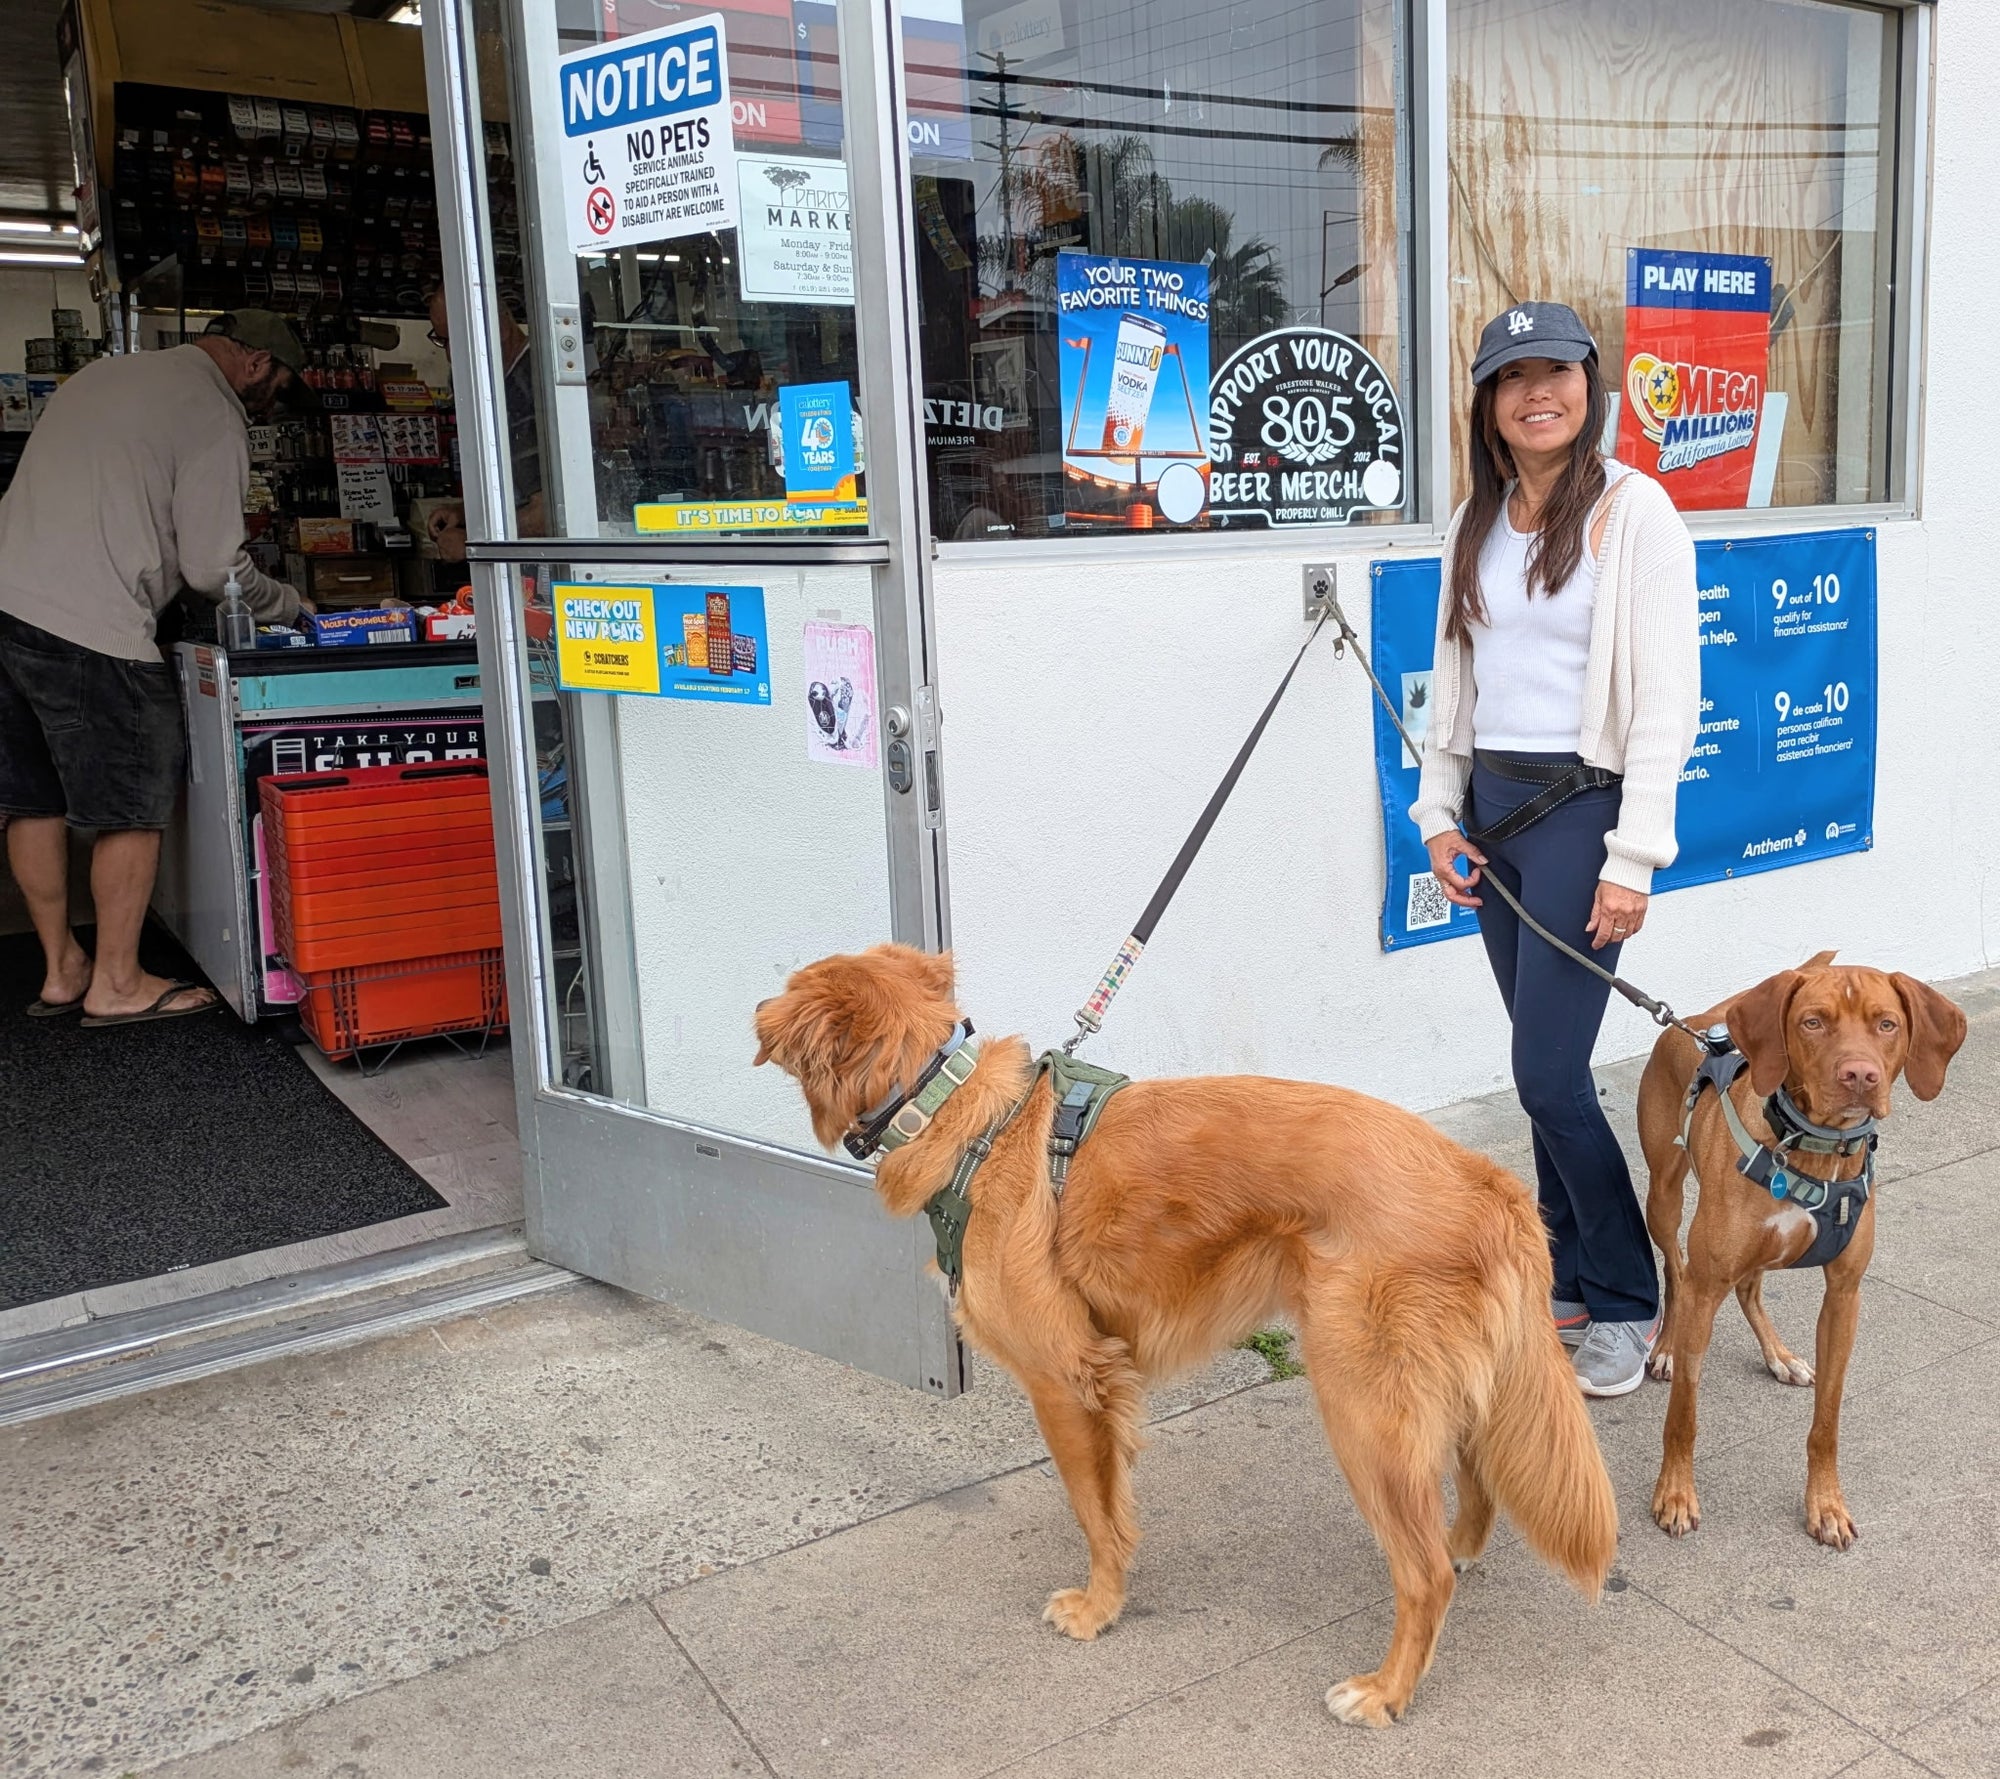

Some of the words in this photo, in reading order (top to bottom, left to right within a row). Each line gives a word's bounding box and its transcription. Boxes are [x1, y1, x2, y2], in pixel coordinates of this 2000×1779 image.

[570, 37, 714, 125] NOTICE
[626, 129, 655, 163] NO
[660, 117, 710, 156] PETS
[633, 158, 667, 176] SERVICE
[667, 150, 705, 168] ANIMALS
[625, 172, 679, 194] SPECIFICALLY
[680, 166, 715, 184] TRAINED
[624, 198, 634, 211] TO
[635, 195, 649, 209] AID
[650, 194, 657, 206] A
[657, 189, 690, 206] PERSON
[691, 185, 712, 200] WITH
[712, 182, 720, 195] A
[621, 207, 664, 228] DISABILITY
[665, 204, 682, 220] ARE
[683, 199, 725, 218] WELCOME
[781, 238, 821, 251] Monday
[773, 261, 820, 273] Saturday
[822, 263, 831, 273] &
[1084, 266, 1136, 285] YOUR
[1141, 268, 1184, 291] TWO
[1643, 265, 1699, 292] PLAY
[1704, 268, 1756, 295] HERE
[1060, 287, 1141, 311] FAVORITE
[1146, 289, 1209, 320] THINGS
[1508, 310, 1533, 336] LA
[1116, 383, 1146, 399] SELTZER
[1117, 372, 1149, 392] VODKA
[1275, 379, 1314, 392] FIRESTONE
[1315, 379, 1342, 393] WALKER
[1671, 362, 1758, 418] MEGA
[1210, 343, 1282, 463] SUPPORT
[1289, 338, 1353, 381] YOUR
[1354, 363, 1399, 462] LOCAL
[1260, 395, 1356, 447] 805
[1661, 411, 1757, 448] MILLIONS
[801, 416, 835, 452] 40
[802, 450, 835, 465] YEARS
[1243, 452, 1261, 464] EST.
[1353, 451, 1372, 463] 2012
[1658, 441, 1727, 472] California
[1726, 431, 1754, 451] Lottery
[1210, 471, 1272, 503] BEER
[676, 508, 710, 525] IT'S
[713, 507, 753, 524] TIME
[755, 506, 779, 522] TO
[1275, 507, 1318, 520] PROPERLY
[1320, 506, 1345, 519] CHILL
[1771, 578, 1788, 610] 9
[1789, 594, 1803, 604] out
[1803, 592, 1813, 603] of
[1813, 573, 1840, 605] 10
[563, 598, 611, 619] CHECK
[612, 600, 642, 620] OUT
[1773, 611, 1801, 626] qualify
[1801, 610, 1813, 621] for
[565, 620, 597, 640] NEW
[1710, 628, 1738, 646] help.
[1773, 624, 1806, 638] financial
[593, 652, 630, 666] SCRATCHERS
[1774, 691, 1791, 722] 9
[1792, 705, 1804, 717] de
[1804, 702, 1823, 715] cada
[1823, 681, 1850, 713] 10
[1776, 723, 1812, 738] personas
[1812, 716, 1843, 730] califican
[313, 734, 389, 749] TAKE
[403, 730, 479, 745] YOUR
[1776, 738, 1796, 751] para
[1797, 732, 1820, 746] recibir
[1776, 747, 1814, 762] asistencia
[1742, 836, 1793, 859] Anthem
